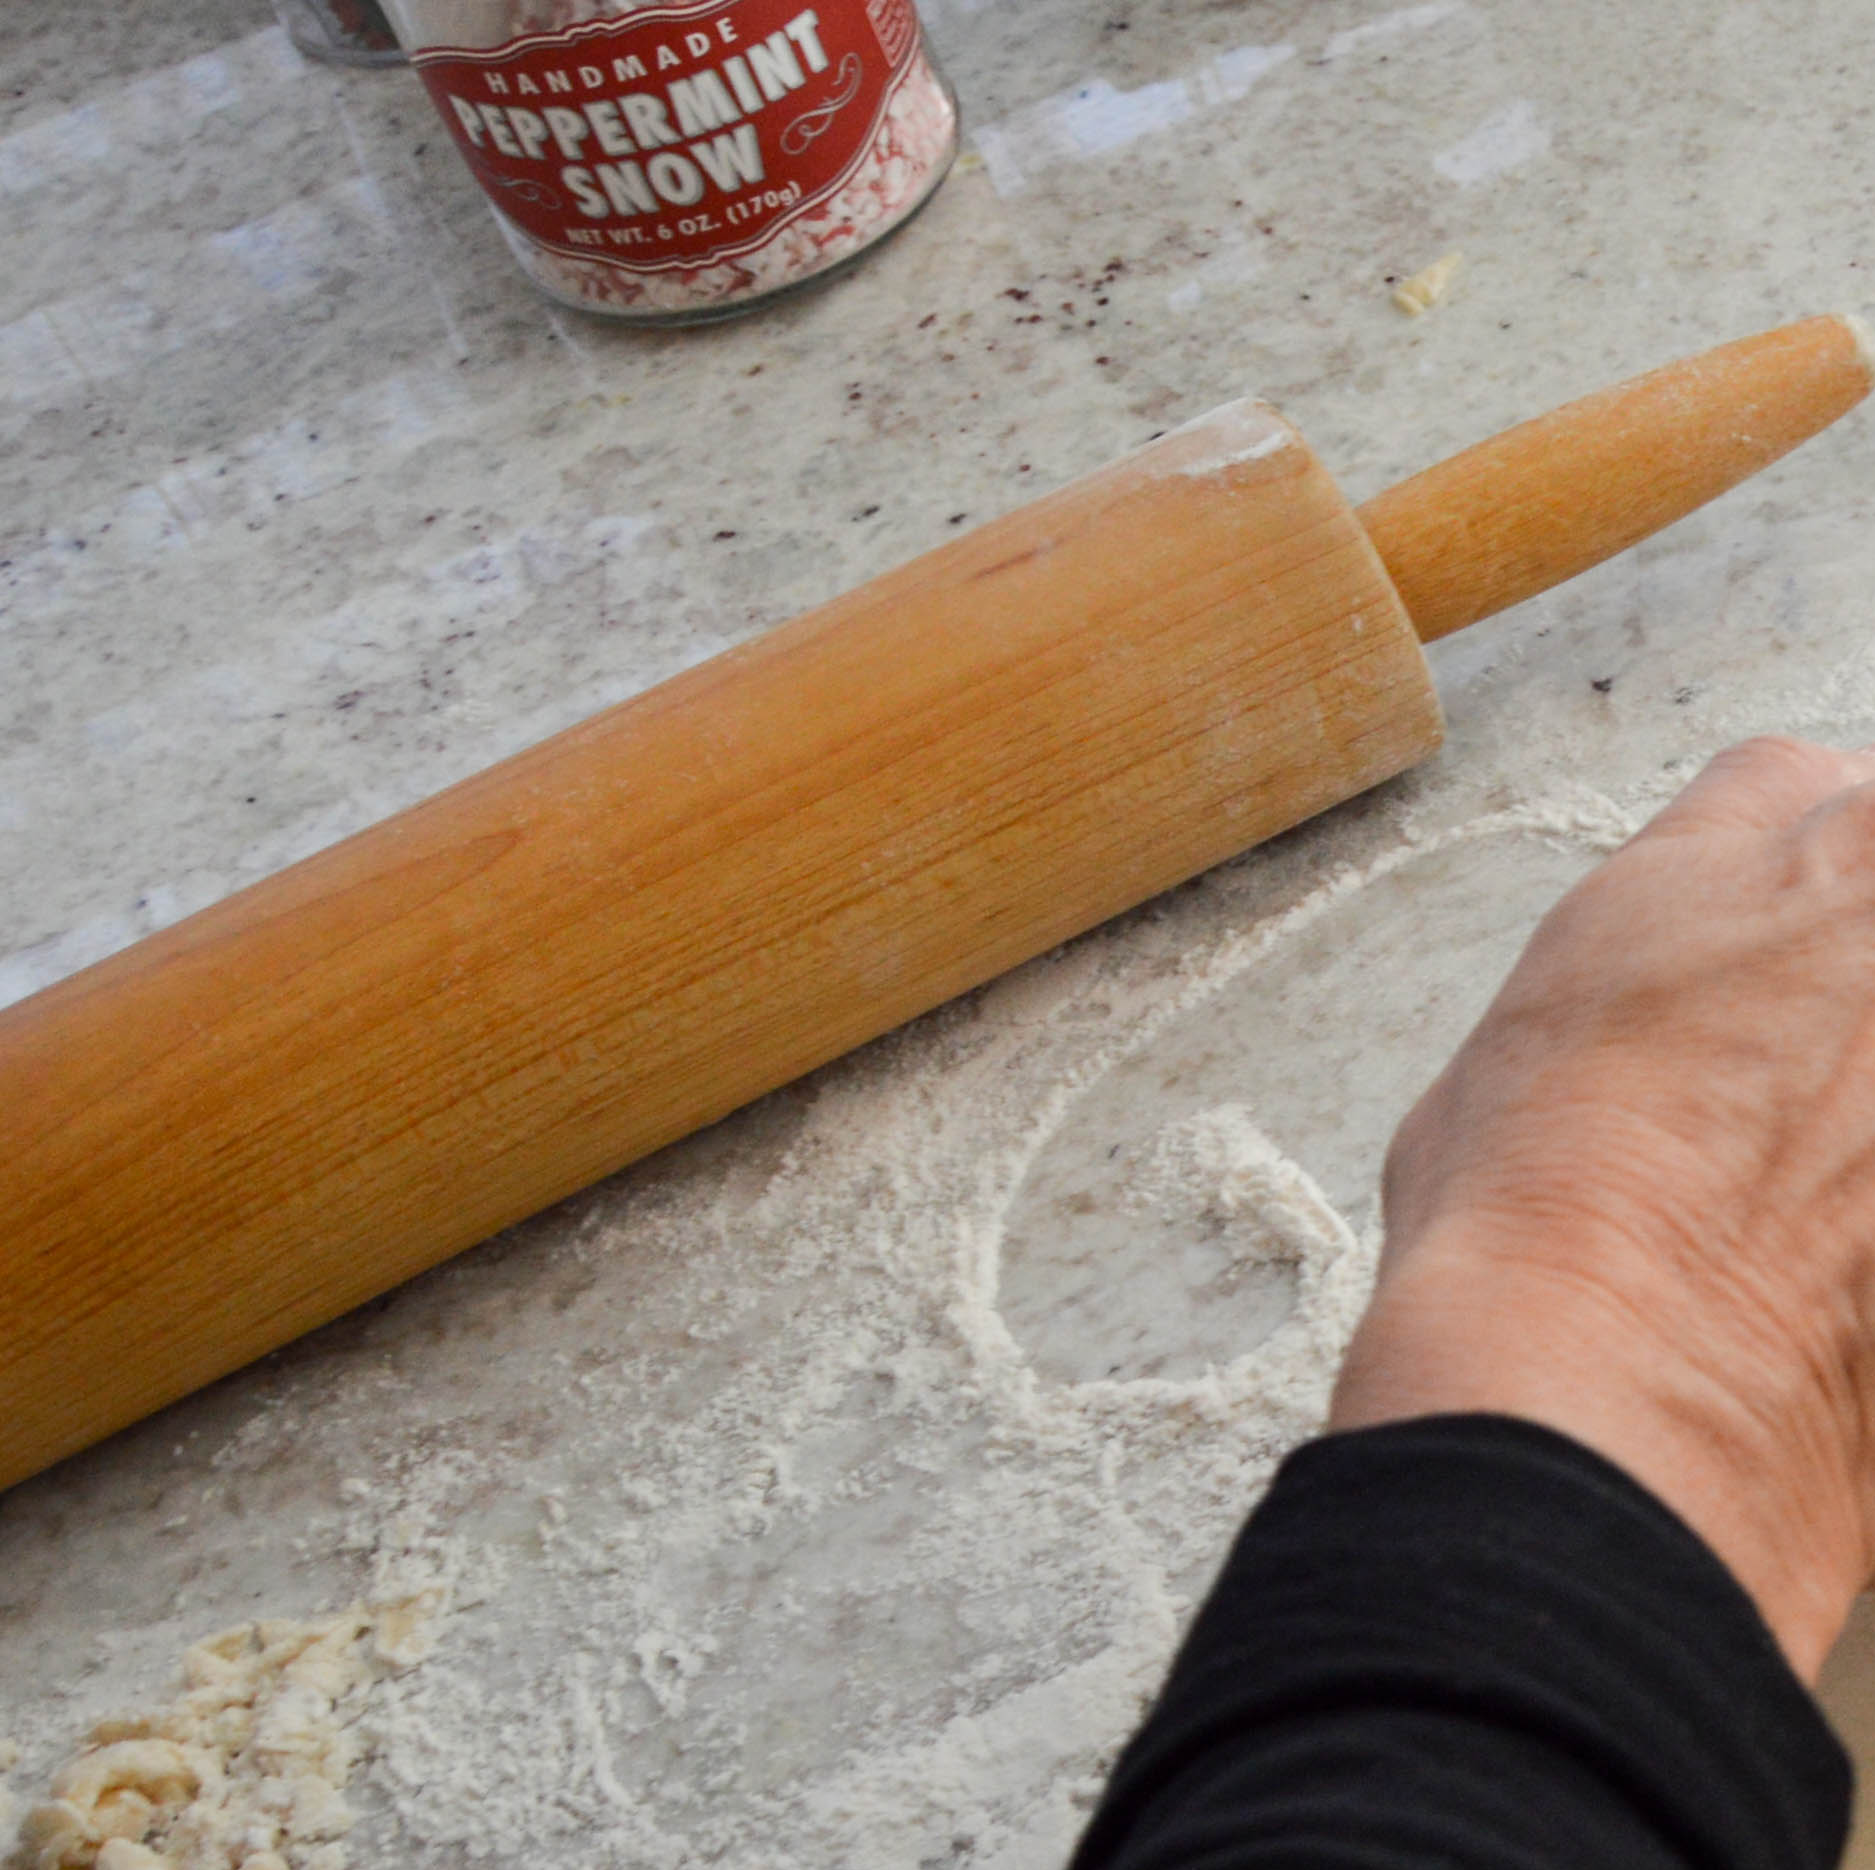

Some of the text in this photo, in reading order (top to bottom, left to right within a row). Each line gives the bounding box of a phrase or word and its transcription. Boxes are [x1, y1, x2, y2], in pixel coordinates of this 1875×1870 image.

[448, 8, 832, 161] PEPPERMINT
[484, 16, 739, 97] HANDMADE
[560, 122, 767, 220] SNOW
[564, 180, 802, 246] NET WT. 6 OZ. (170g)
